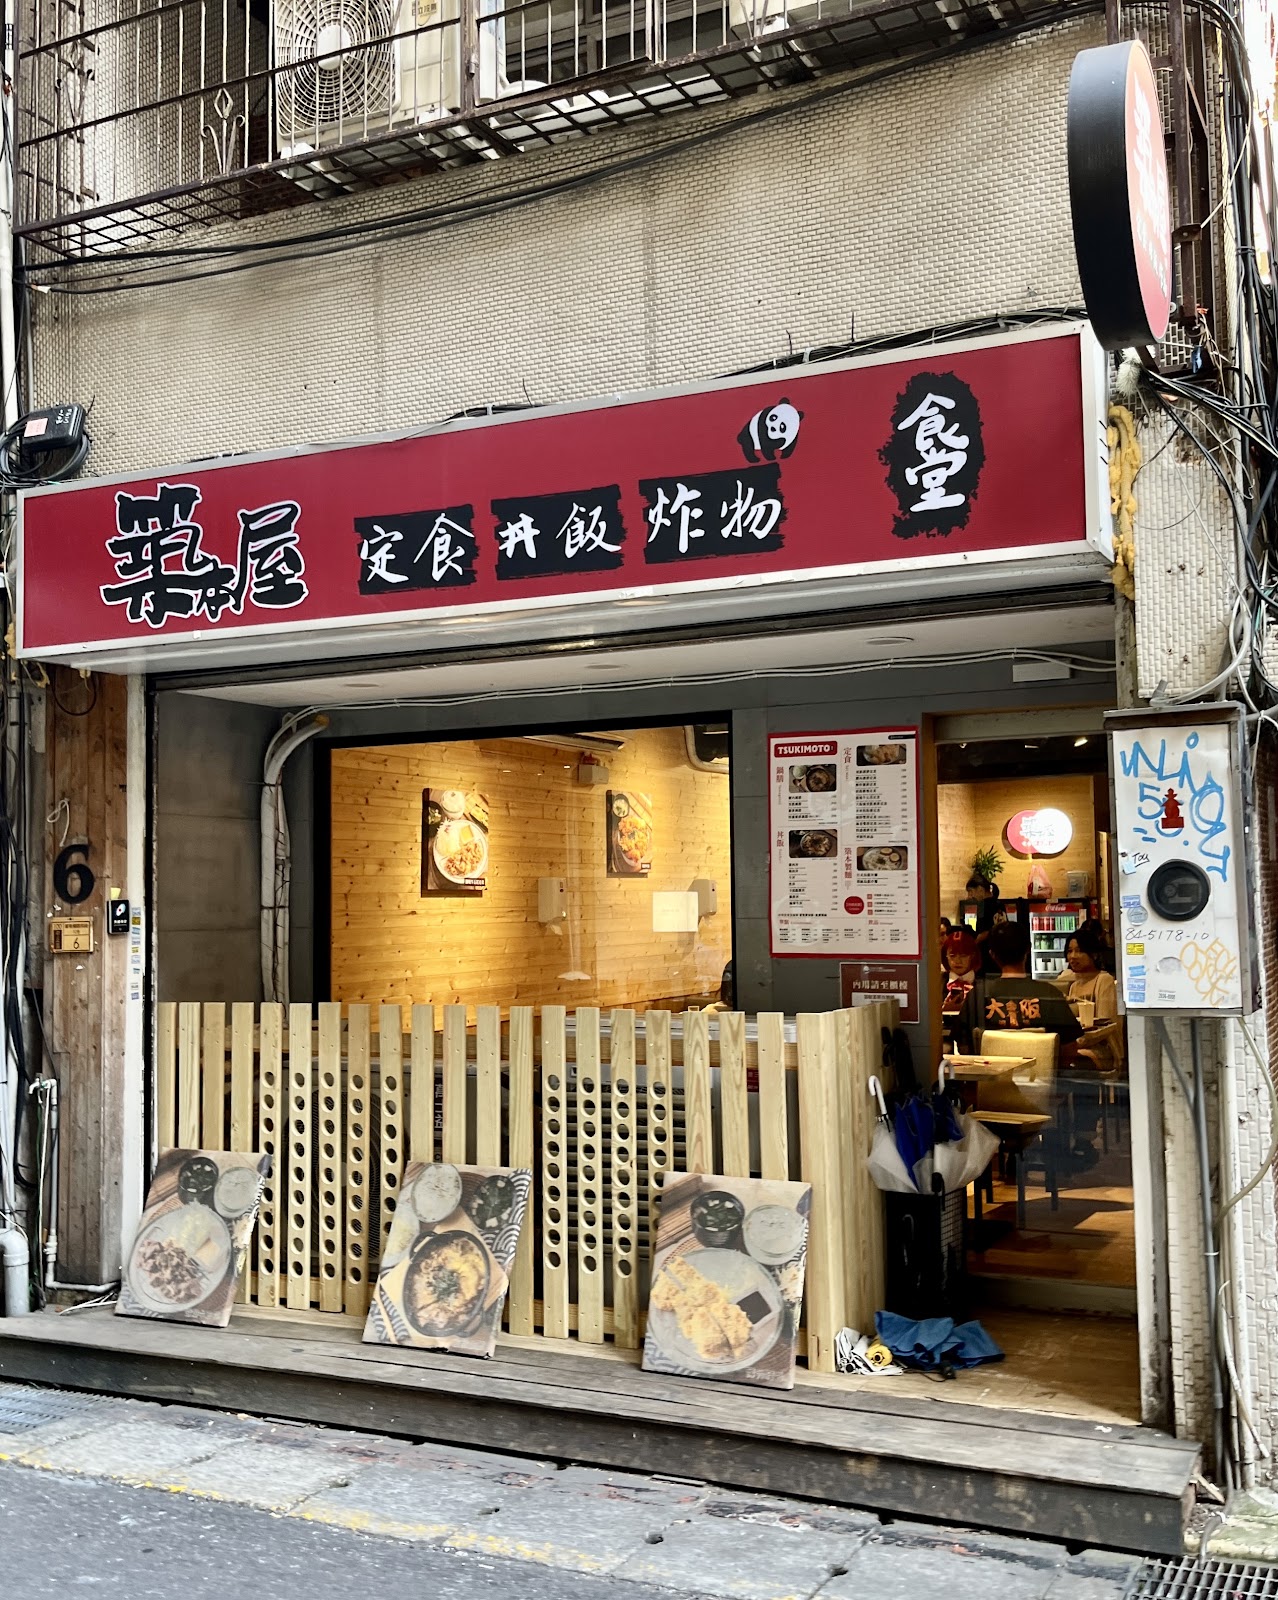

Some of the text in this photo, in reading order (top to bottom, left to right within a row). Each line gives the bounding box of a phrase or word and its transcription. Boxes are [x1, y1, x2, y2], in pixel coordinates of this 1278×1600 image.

[898, 392, 969, 513] 食堂
[360, 479, 783, 583] 定食 丼飯 炸物
[777, 744, 831, 755] TSUKIMOTO
[53, 844, 94, 904] 6
[73, 937, 80, 950] 6
